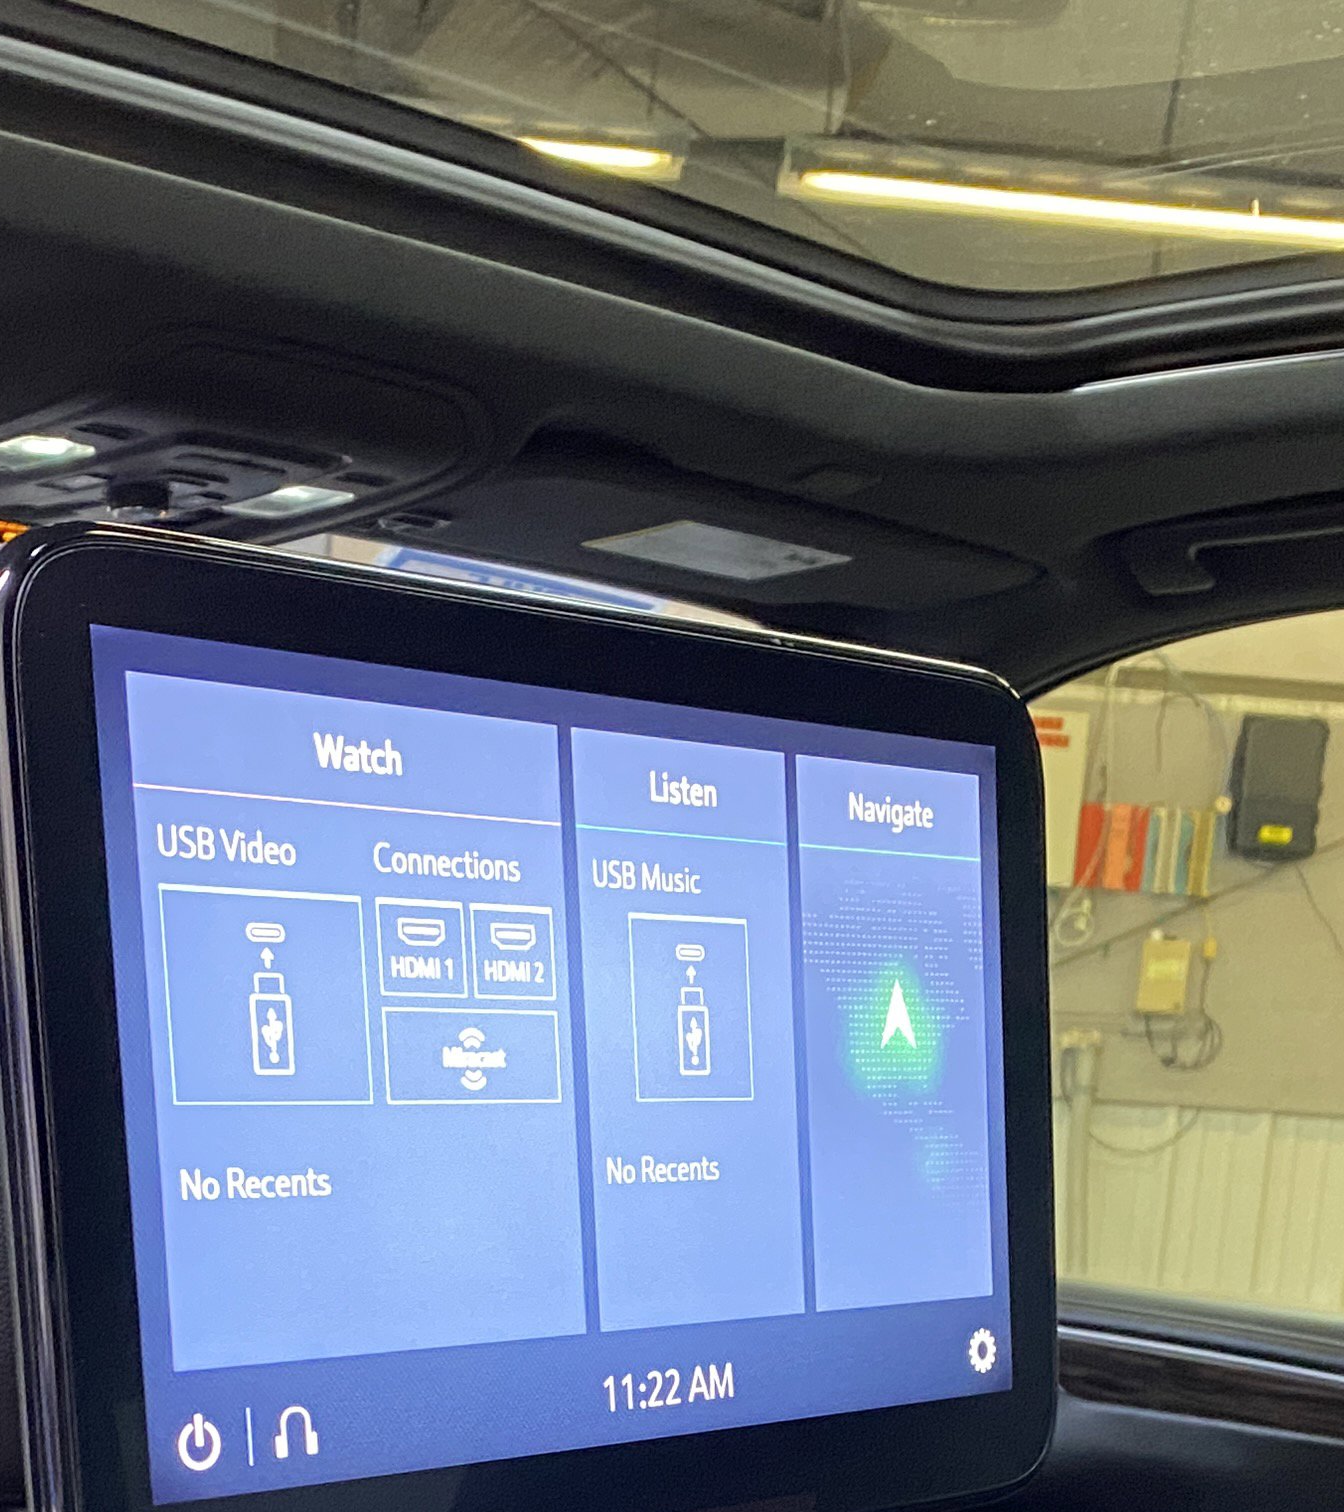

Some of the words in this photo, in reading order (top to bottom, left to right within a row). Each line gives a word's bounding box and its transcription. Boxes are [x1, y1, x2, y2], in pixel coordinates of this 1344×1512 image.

[312, 731, 404, 776] Watch
[648, 770, 718, 808] Listen
[848, 791, 934, 834] Navigate
[156, 823, 215, 861] USB
[219, 828, 297, 866] Video
[372, 841, 522, 883] Connections
[591, 857, 636, 890] USB
[641, 861, 702, 895] Music
[390, 954, 441, 980] HDMI
[444, 957, 454, 981] 1
[483, 959, 531, 983] HDMI
[532, 961, 545, 984] 2
[179, 1167, 221, 1202] No
[226, 1166, 332, 1200] Recents
[605, 1155, 637, 1186] No
[640, 1154, 721, 1184] Recents
[601, 1368, 682, 1413] 11:22
[687, 1361, 736, 1404] AM
